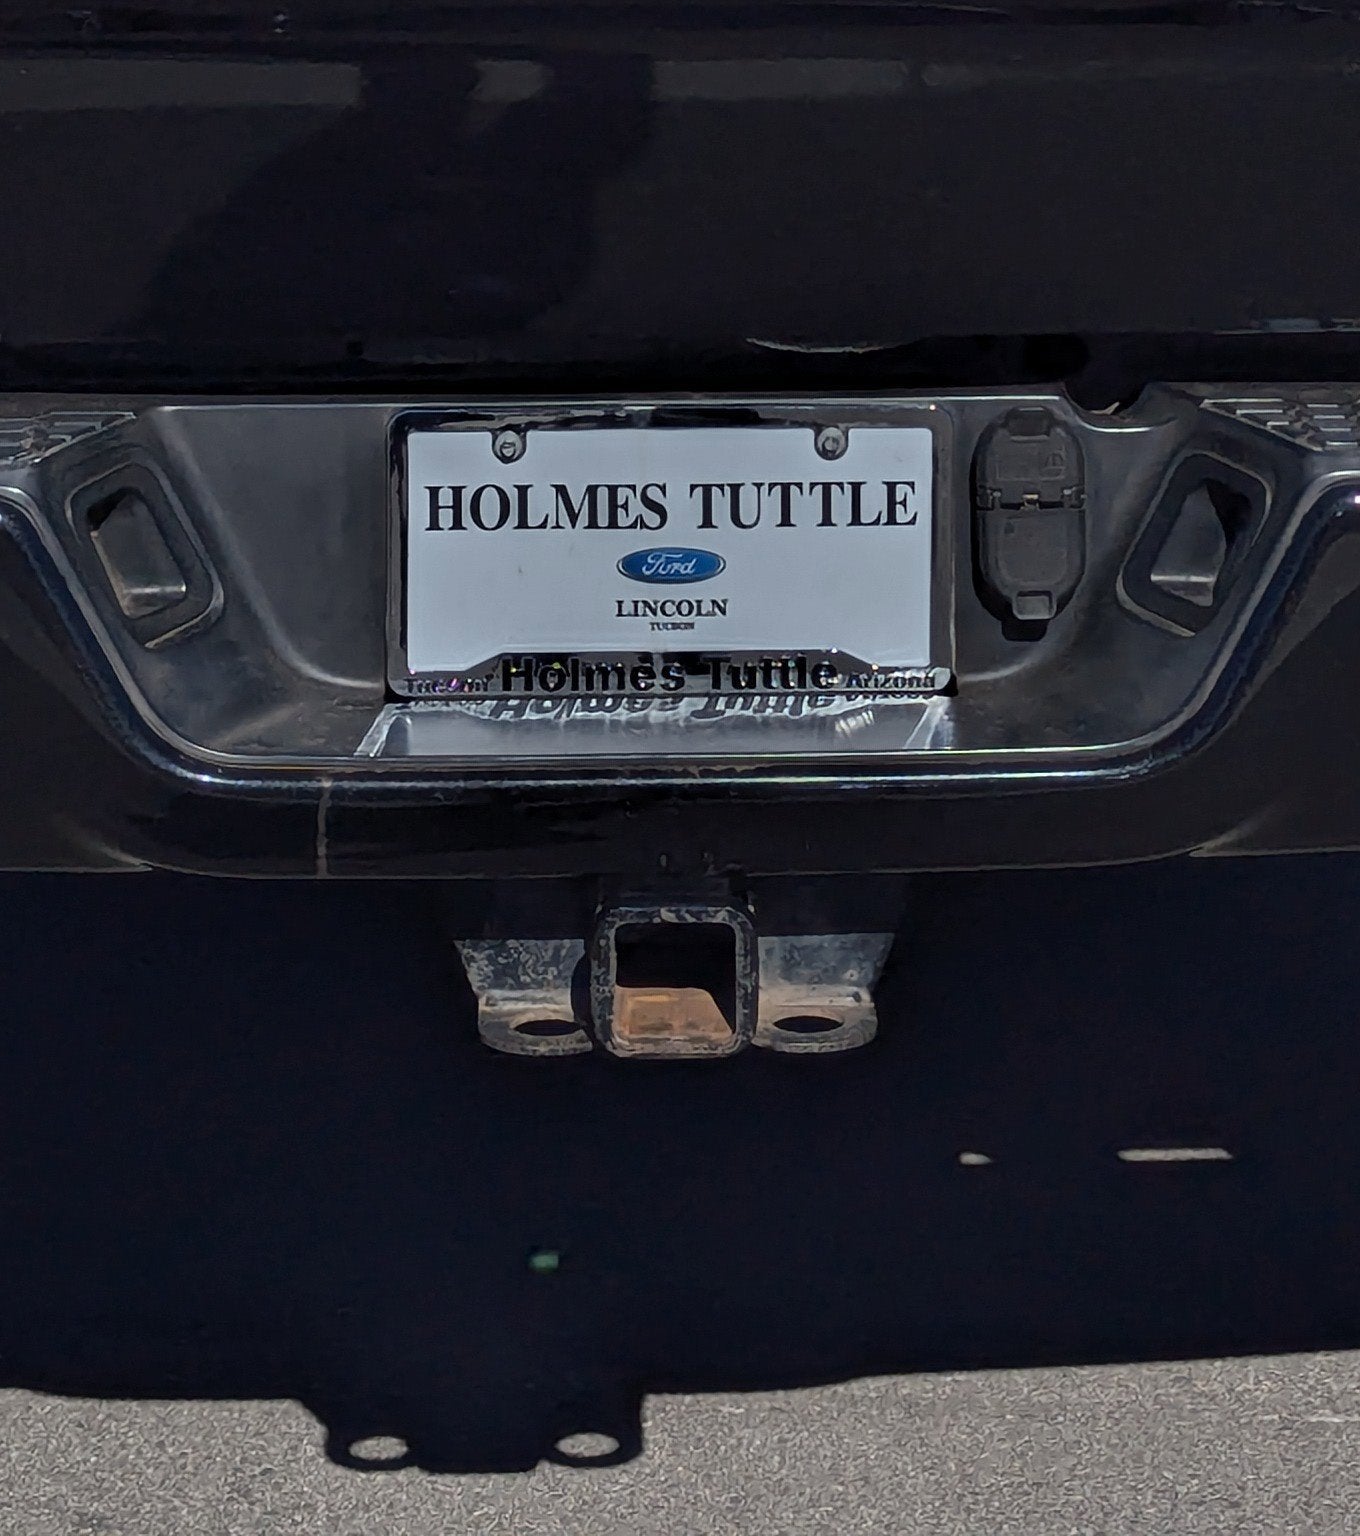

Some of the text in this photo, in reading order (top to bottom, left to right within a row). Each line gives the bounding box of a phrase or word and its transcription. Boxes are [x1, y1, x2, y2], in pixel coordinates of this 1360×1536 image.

[424, 481, 918, 531] HOLMES TUTTLE
[642, 552, 697, 575] Ford
[615, 598, 728, 617] LINCOLN
[501, 657, 686, 692] Holmes
[701, 656, 839, 690] Tuttle
